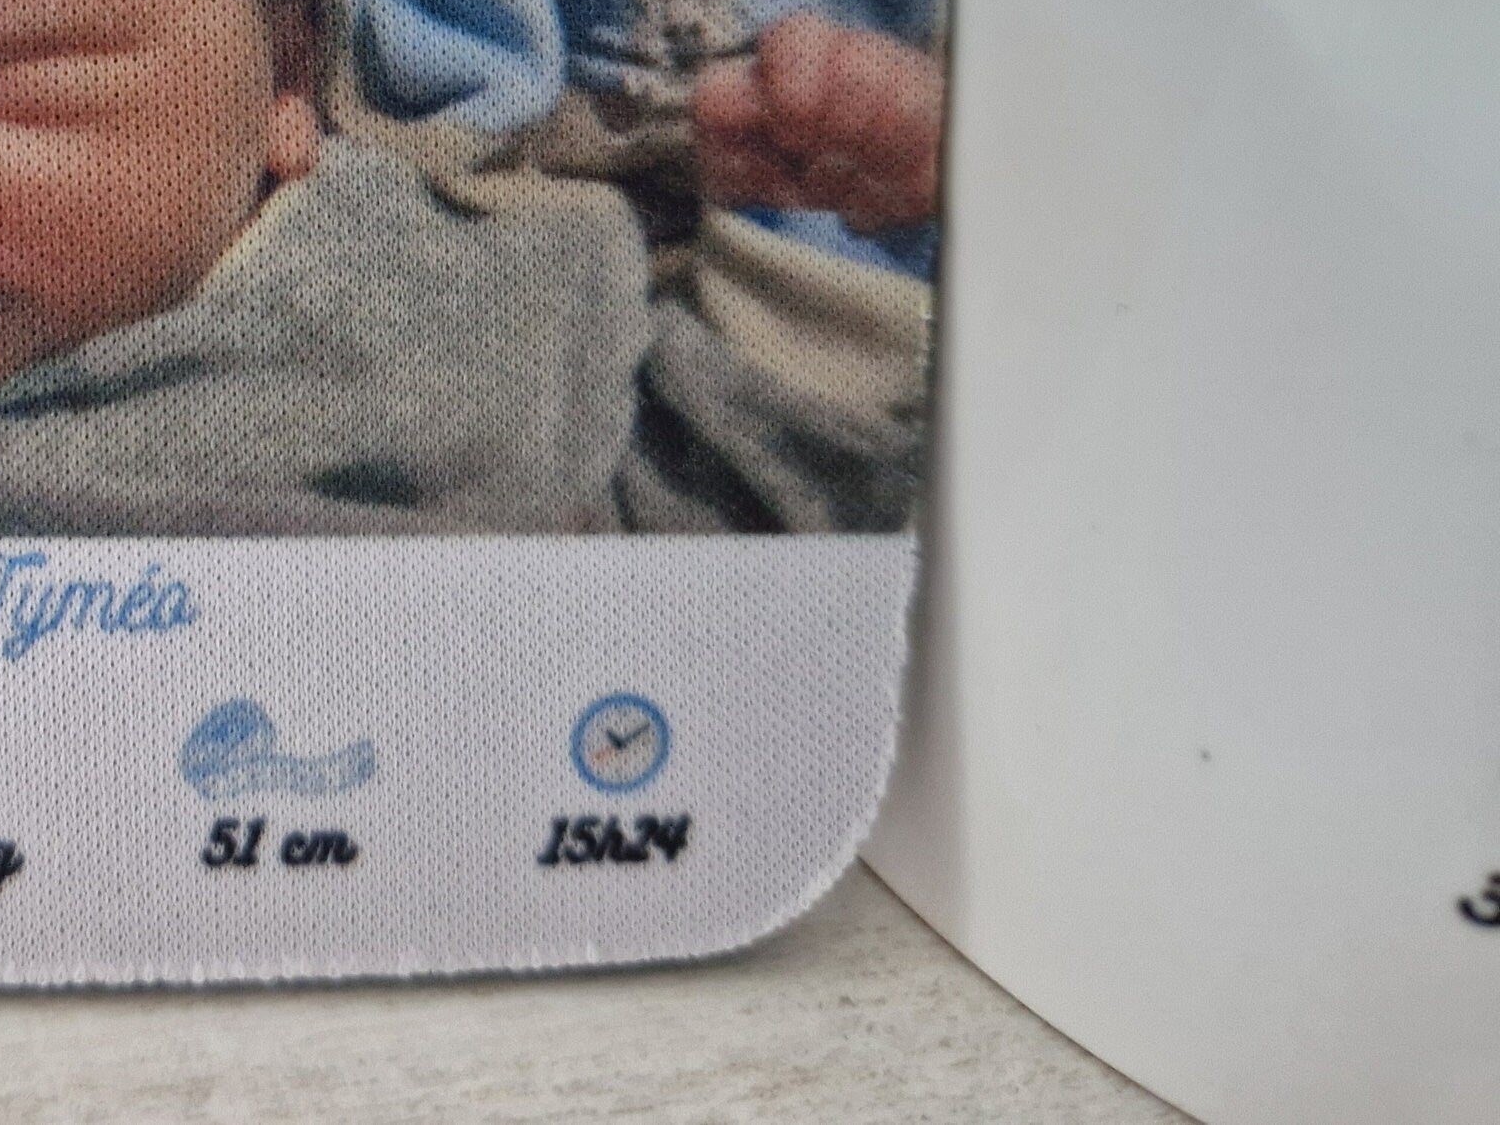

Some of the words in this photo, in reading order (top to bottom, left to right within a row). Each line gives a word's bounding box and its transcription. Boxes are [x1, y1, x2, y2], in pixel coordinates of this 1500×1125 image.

[202, 816, 267, 866] 51
[281, 830, 359, 865] cm
[537, 813, 690, 865] 15h24
